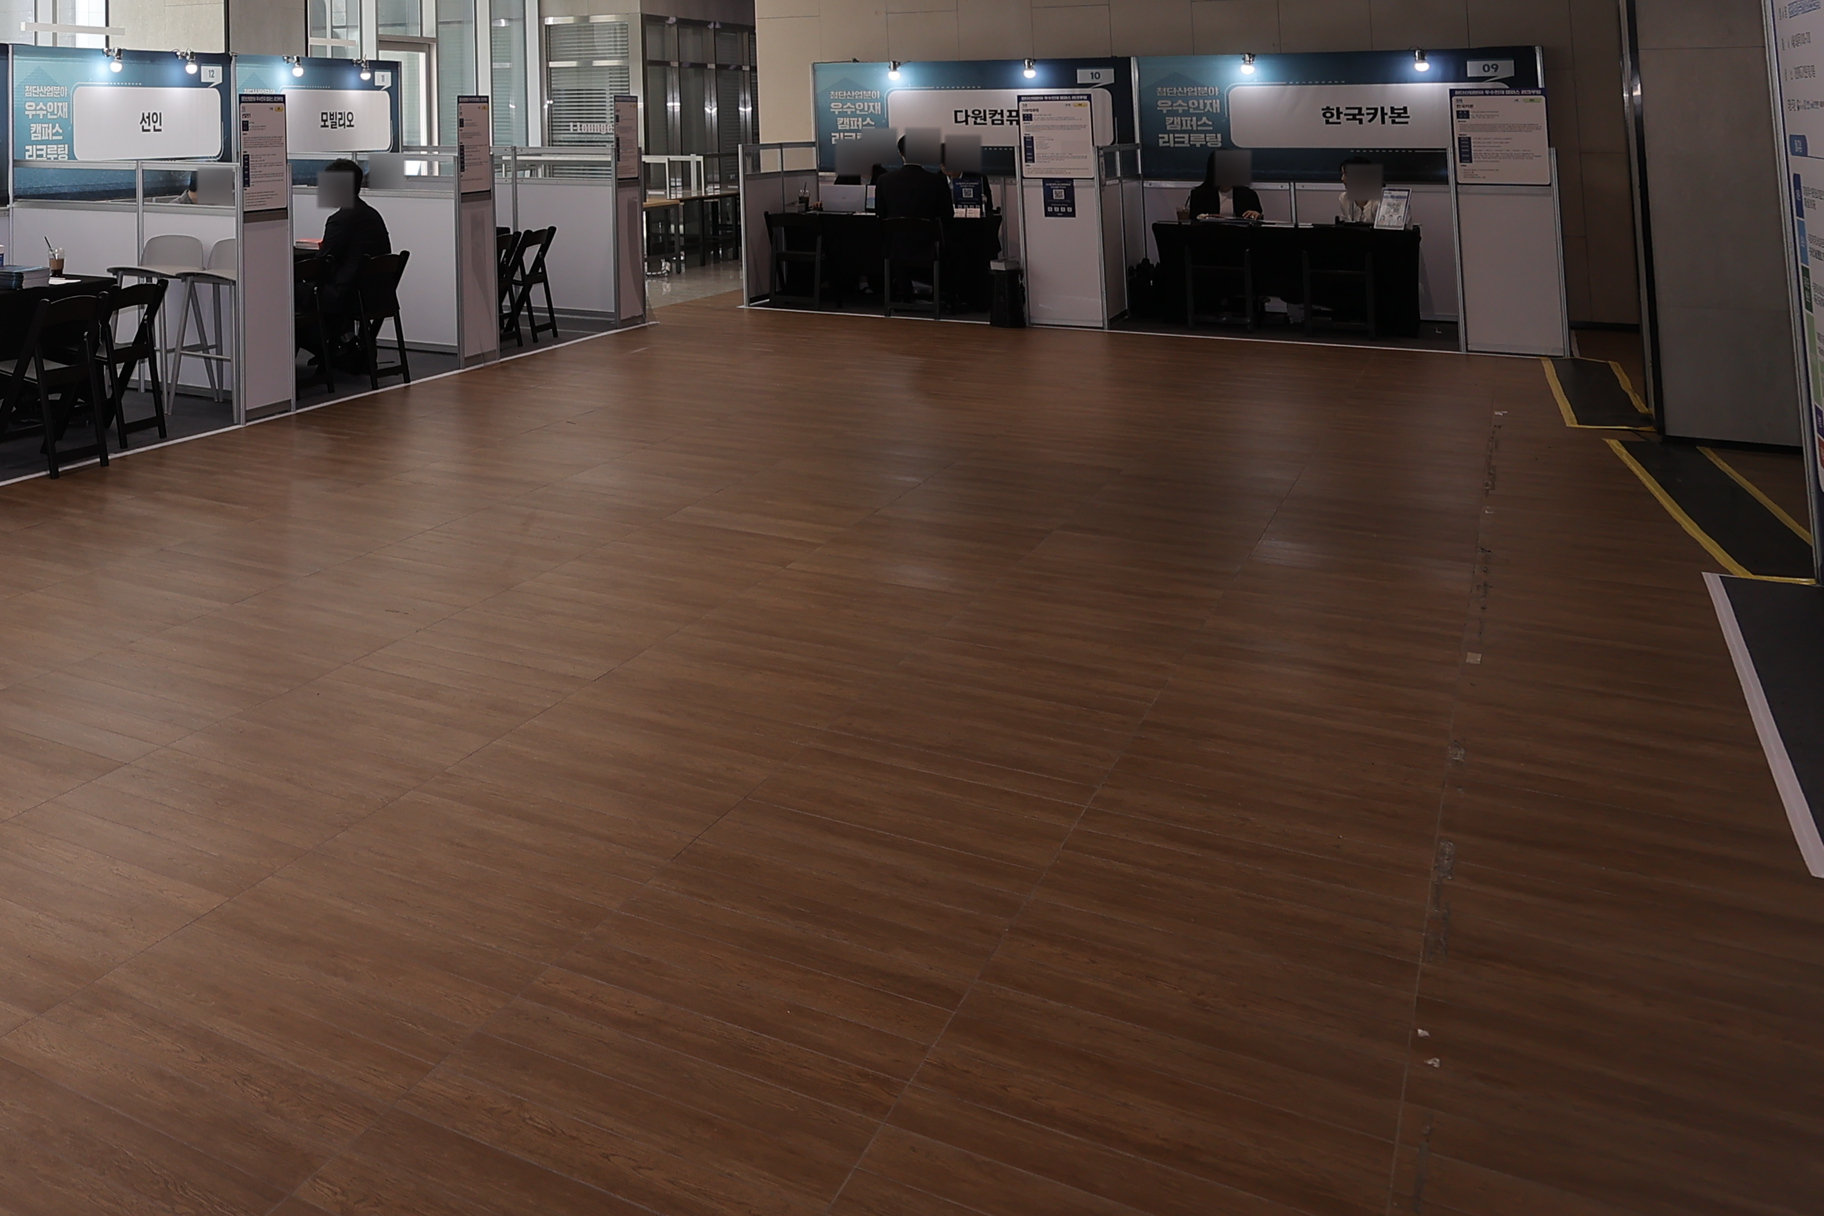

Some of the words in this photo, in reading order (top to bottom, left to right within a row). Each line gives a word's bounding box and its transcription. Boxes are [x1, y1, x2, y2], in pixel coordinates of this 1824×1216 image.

[1090, 71, 1101, 80] 10
[1482, 63, 1499, 73] 09
[24, 85, 68, 97] 첨단산업분야
[830, 90, 881, 100] 첨단산업분야
[1156, 86, 1219, 96] 첨단산업분야
[24, 101, 68, 119] 우수인재
[830, 102, 881, 115] 우수인재
[1157, 99, 1220, 114] 우수인재
[139, 111, 163, 133] 선인
[320, 110, 355, 130] 모빌리오
[837, 117, 875, 130] 캠퍼스
[954, 109, 1019, 126] 다원컴퓨
[1165, 116, 1214, 131] 캠퍼스
[1321, 106, 1410, 126] 한국카본
[30, 123, 63, 140] 캠퍼스
[1158, 133, 1222, 148] 리크루팅
[25, 144, 68, 161] 리크루팅
